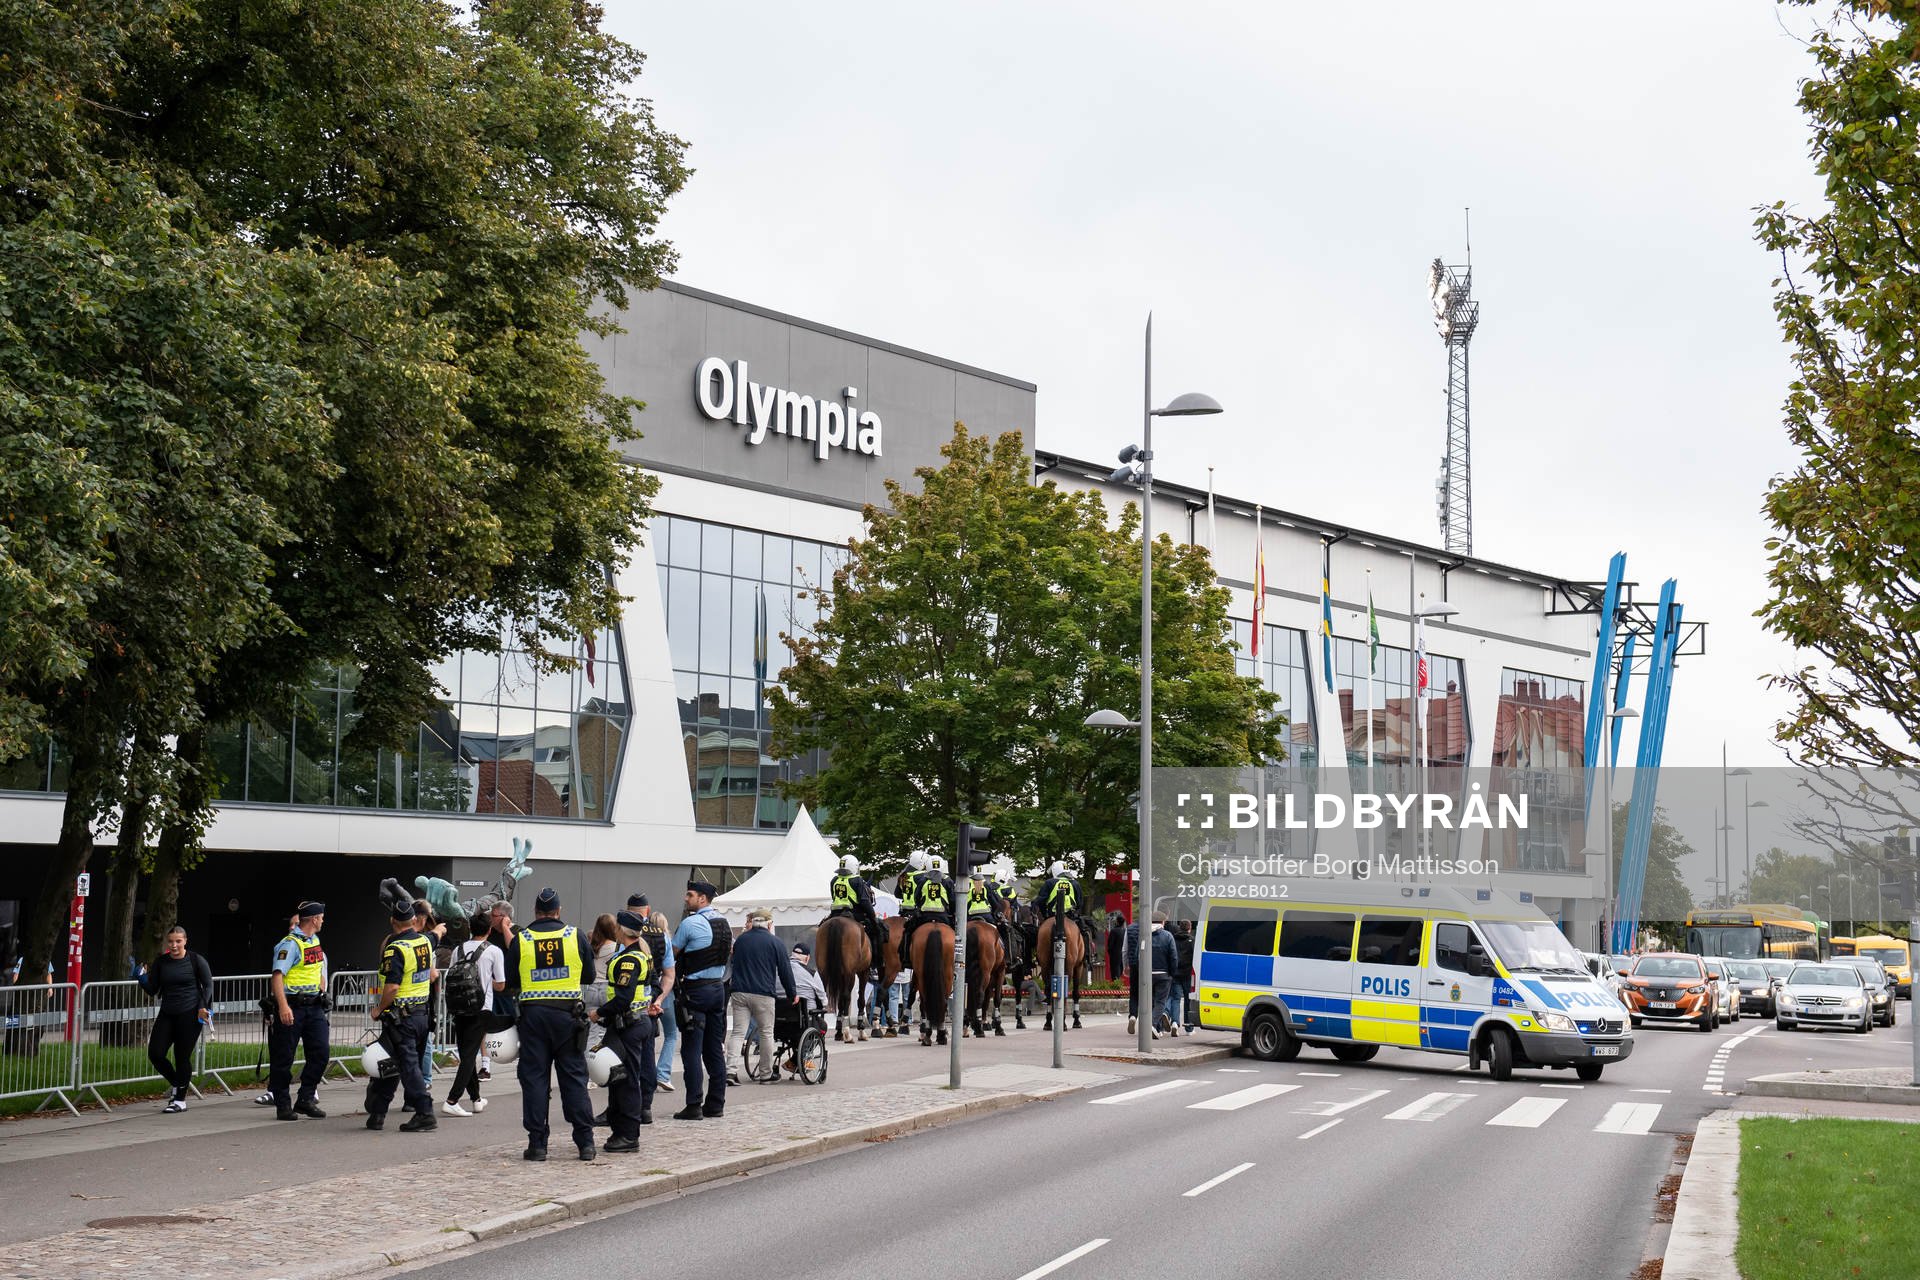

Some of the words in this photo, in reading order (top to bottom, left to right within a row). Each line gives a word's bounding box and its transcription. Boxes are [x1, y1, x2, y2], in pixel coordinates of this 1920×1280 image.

[696, 356, 883, 460] Olympia
[931, 890, 937, 898] 5
[642, 925, 663, 933] OLIS
[415, 944, 429, 957] K61
[538, 940, 559, 952] K61
[421, 956, 427, 969] 5
[546, 952, 554, 966] 5
[531, 966, 569, 981] POLIS
[1361, 975, 1410, 997] POLIS
[1555, 991, 1617, 1009] POLIS
